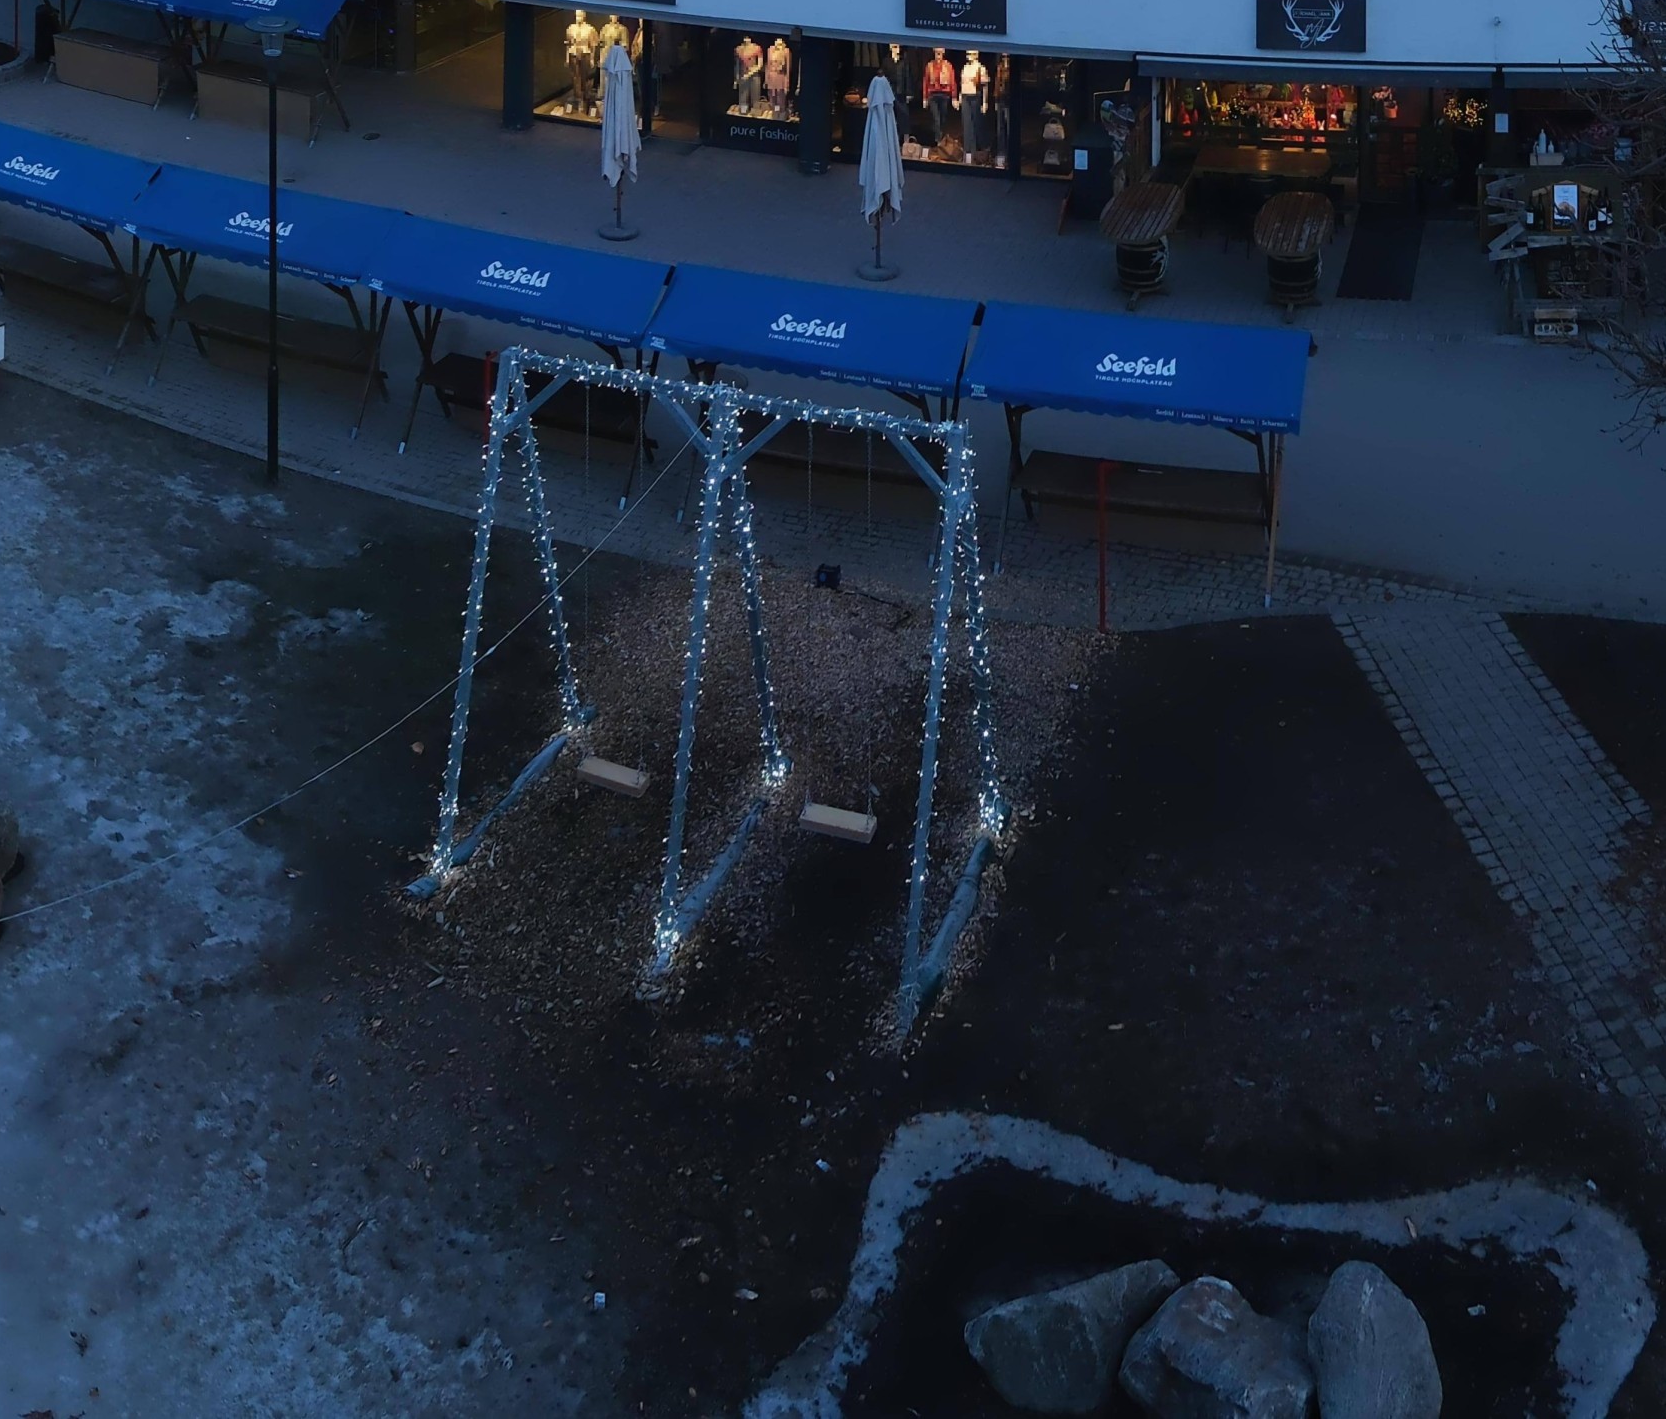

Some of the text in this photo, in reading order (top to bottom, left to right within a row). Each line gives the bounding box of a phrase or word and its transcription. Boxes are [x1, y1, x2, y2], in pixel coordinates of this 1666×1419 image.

[915, 19, 943, 27] SEEFELD
[947, 22, 981, 30] SHOPPING
[730, 126, 755, 137] pure
[4, 156, 60, 180] Seefeld
[480, 261, 551, 288] Seefeld
[770, 313, 847, 340] Seefeld
[1096, 353, 1177, 377] Seefeld
[1095, 374, 1173, 387] TIROLS HOCHPLATEAU
